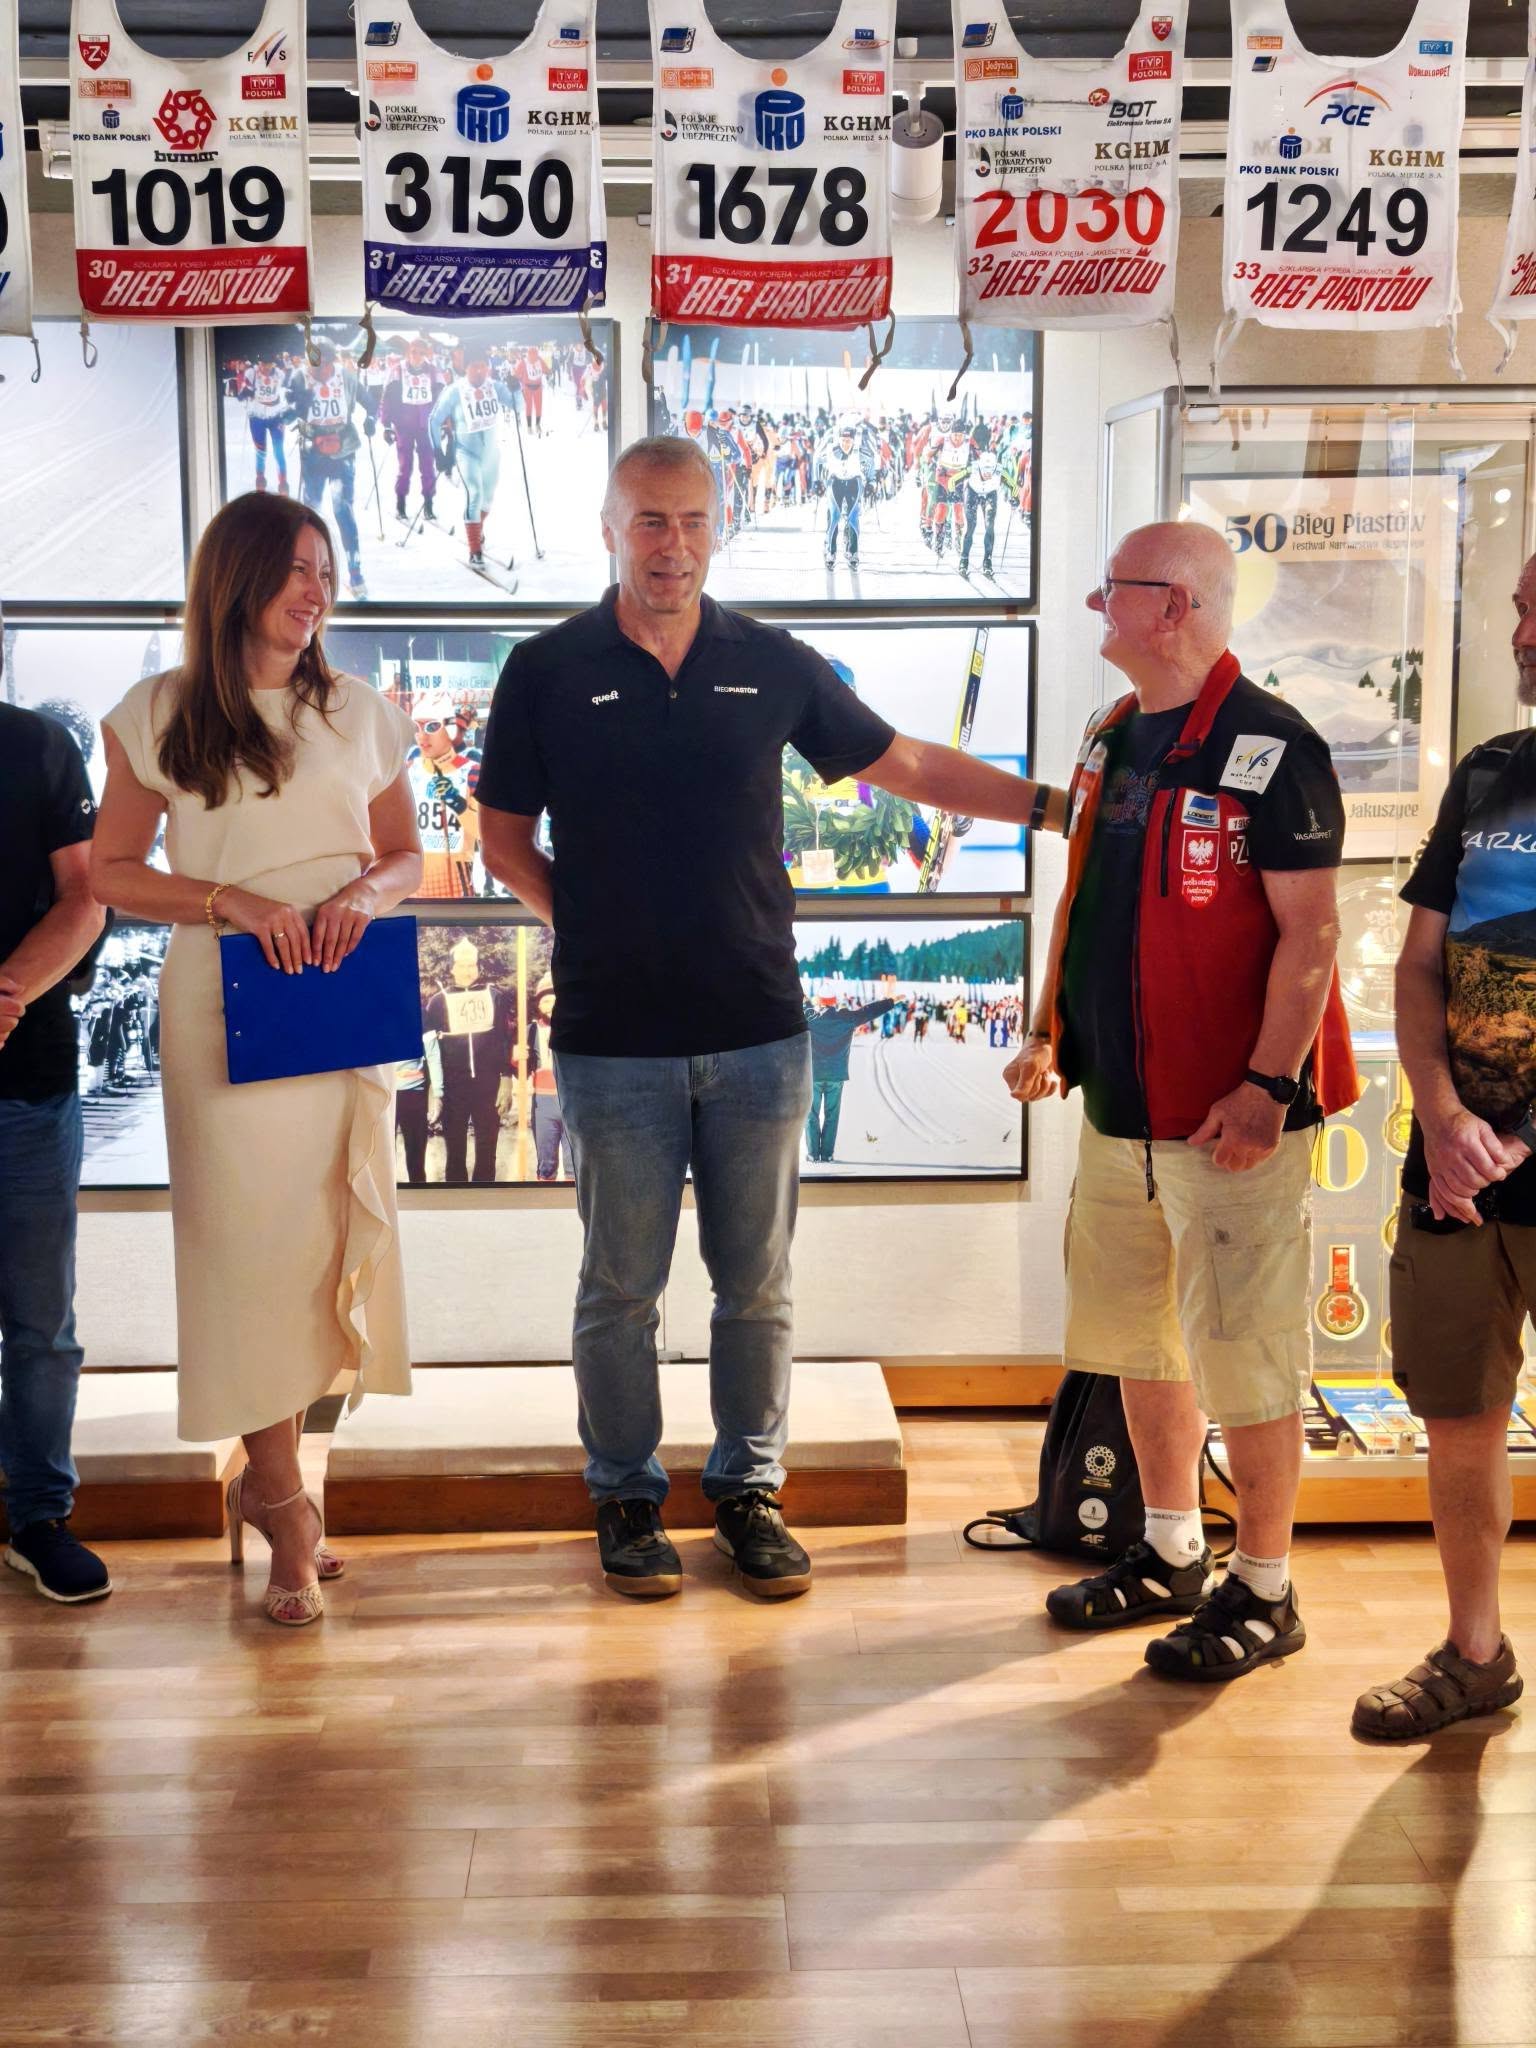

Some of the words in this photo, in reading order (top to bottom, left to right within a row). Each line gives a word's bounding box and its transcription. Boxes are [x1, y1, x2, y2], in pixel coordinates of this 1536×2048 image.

[1444, 43, 1449, 52] 1
[1138, 58, 1162, 69] TVP
[251, 79, 276, 89] TVP
[1132, 71, 1168, 79] POLONIA
[245, 90, 282, 98] POLONIA
[1109, 100, 1157, 118] BOT
[1320, 104, 1375, 126] PGE
[228, 116, 298, 131] KGHM
[386, 115, 446, 124] TOWARZYSTWO
[528, 111, 591, 126] KGHM
[681, 114, 717, 123] POLSKIE
[824, 116, 891, 131] KGHM
[681, 124, 743, 133] TOWARZYSTWO
[965, 129, 986, 139] PKO
[989, 127, 1019, 137] BANK
[1022, 126, 1062, 136] POLSKI
[154, 150, 218, 162] bumar
[995, 150, 1026, 158] POLSKIE
[1094, 139, 1171, 160] KGHM
[1369, 150, 1444, 167] KGHM
[995, 158, 1052, 166] TOWARZYSTWO
[1240, 166, 1261, 174] PKO
[1265, 166, 1296, 174] BANK
[1300, 167, 1339, 176] POLSKI
[385, 152, 573, 239] 3150
[92, 166, 285, 245] 1019
[686, 164, 868, 246] 1678
[973, 187, 1165, 249] 2030
[1247, 182, 1428, 256] 1249
[369, 250, 396, 270] 31
[415, 255, 462, 263] SZKLARSKA
[503, 258, 550, 266] JAKUSZYCE
[1011, 249, 1053, 258] SZKLARSKA
[89, 260, 117, 278] 30
[967, 253, 994, 276] 32
[666, 264, 693, 284] 31
[979, 259, 1050, 300] BIEG
[1041, 254, 1166, 297] PIASTÓW
[101, 270, 175, 306] BIEG
[168, 263, 295, 306] PIASTÓW
[381, 264, 457, 304] BIEG
[449, 263, 587, 306] PIASTÓW
[1233, 262, 1261, 279] 33
[1306, 270, 1433, 312] PIASTÓW
[678, 276, 754, 315] BIEG
[745, 272, 887, 319] PIASTÓW
[407, 387, 427, 399] 476
[311, 400, 339, 417] 670
[468, 399, 498, 420] 1490
[1225, 513, 1288, 554] 50
[1292, 514, 1335, 538] Bieg
[416, 675, 430, 689] PKO
[592, 690, 619, 705] quest
[1235, 755, 1268, 767] FIS
[417, 801, 461, 832] 854
[1349, 803, 1419, 820] Jakuszyce
[1230, 836, 1249, 864] PZ
[1461, 831, 1536, 853] ARK
